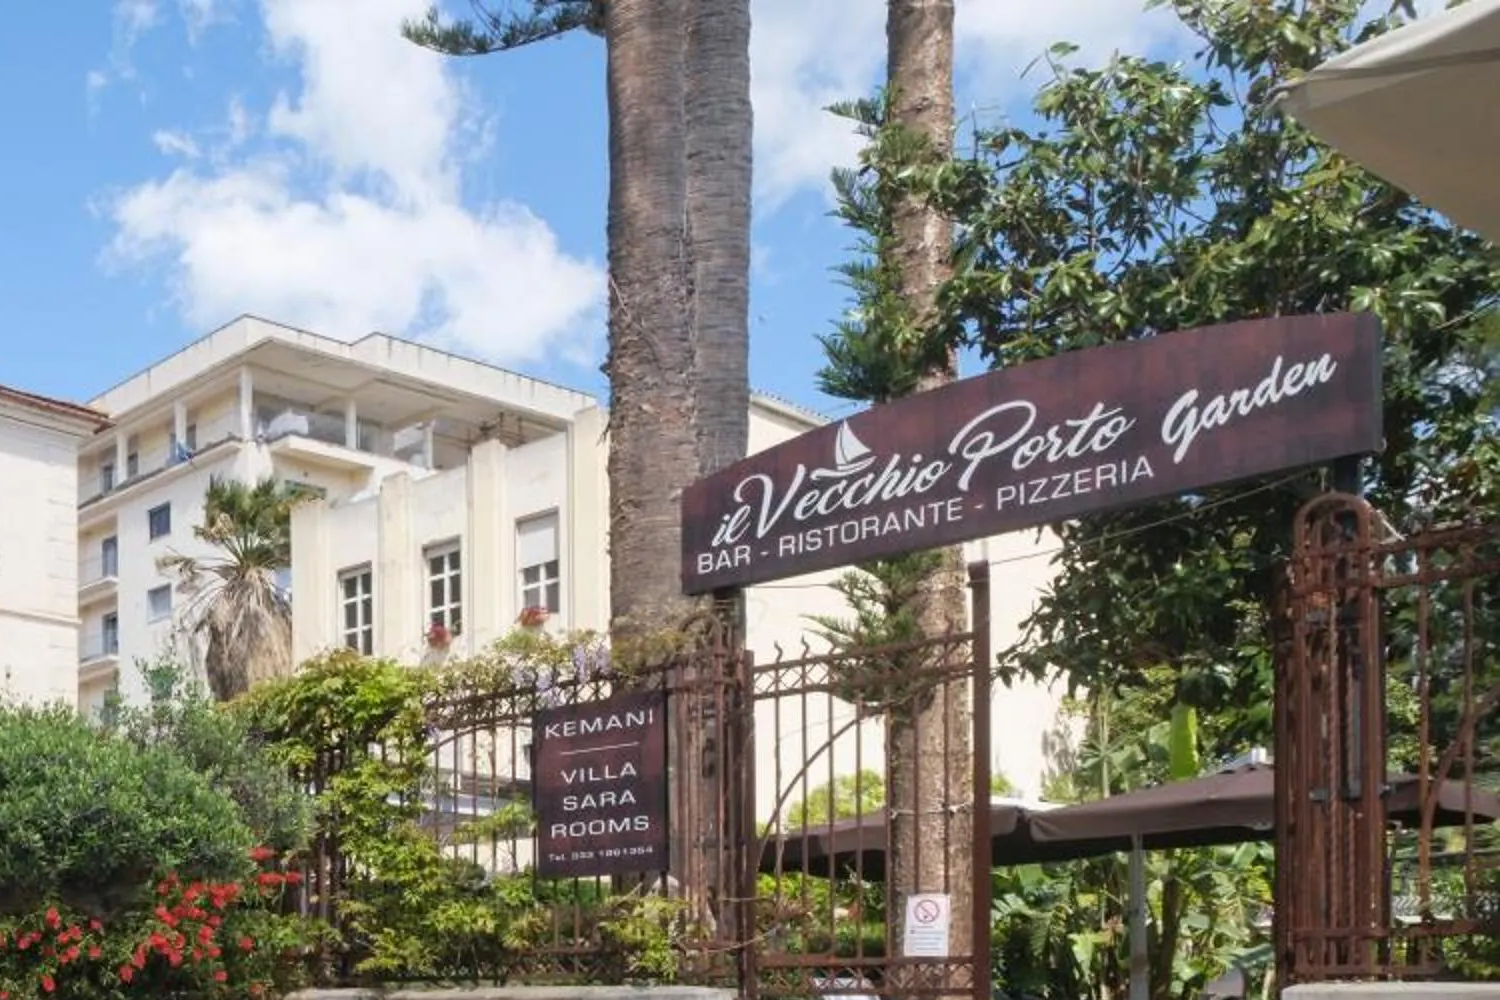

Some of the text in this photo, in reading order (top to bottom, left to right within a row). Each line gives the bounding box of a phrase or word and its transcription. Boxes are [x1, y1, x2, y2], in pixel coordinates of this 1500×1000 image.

[711, 352, 1338, 547] il Vecchio Porto Garden
[697, 545, 751, 575] BAR
[778, 497, 964, 558] RISTORANTE
[996, 455, 1155, 511] PIZZERIA
[544, 709, 653, 740] KEMANI
[560, 761, 637, 785] VILLA
[563, 789, 637, 811] SARA
[551, 815, 650, 839] ROOMS
